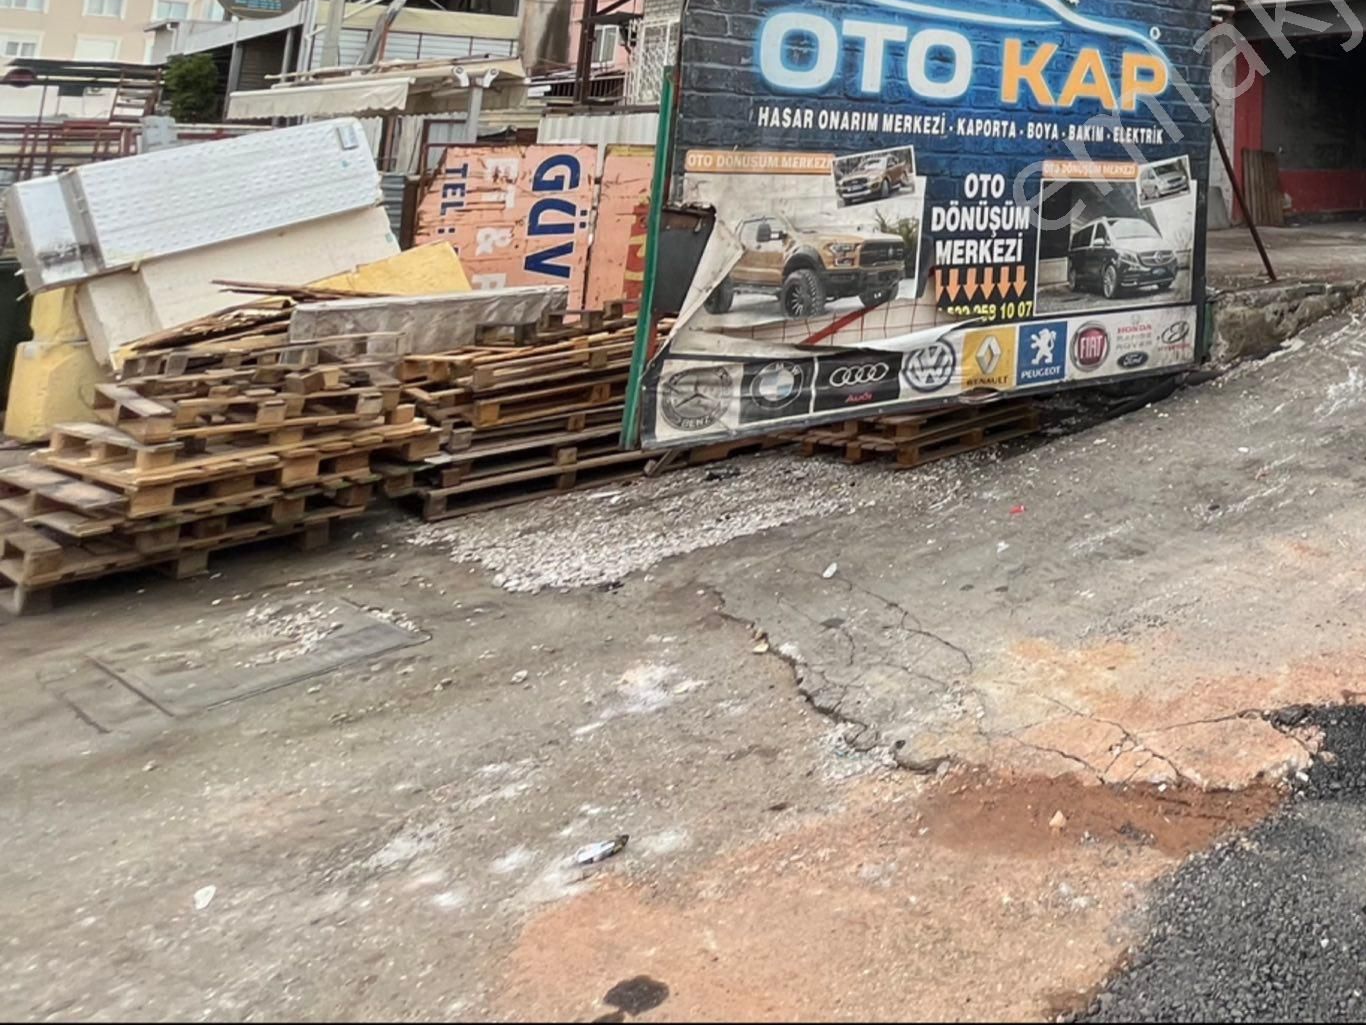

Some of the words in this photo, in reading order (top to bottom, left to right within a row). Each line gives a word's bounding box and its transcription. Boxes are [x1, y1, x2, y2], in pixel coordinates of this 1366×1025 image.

[759, 12, 973, 99] OTO
[1001, 38, 1169, 111] KAP
[758, 106, 813, 129] HASAR
[818, 110, 878, 131] ONARIM
[882, 113, 946, 135] MERKEZİ
[956, 118, 1016, 139] KAPORTA
[1027, 122, 1059, 141] BOYA
[1068, 125, 1104, 142] BAKIM
[1113, 125, 1164, 144] ELEKTRİK
[687, 154, 713, 167] OTO
[964, 173, 1005, 199] OTO
[524, 154, 588, 279] GÜV
[931, 200, 1031, 238] DÖNÜŞÜM
[935, 232, 1023, 265] MERKEZİ
[1000, 302, 1015, 319] 10
[1018, 301, 1033, 317] 07
[1080, 335, 1103, 359] FIAT
[966, 376, 1008, 386] RENAULT
[1021, 366, 1061, 379] PEUGEOT
[845, 392, 872, 403] Audi
